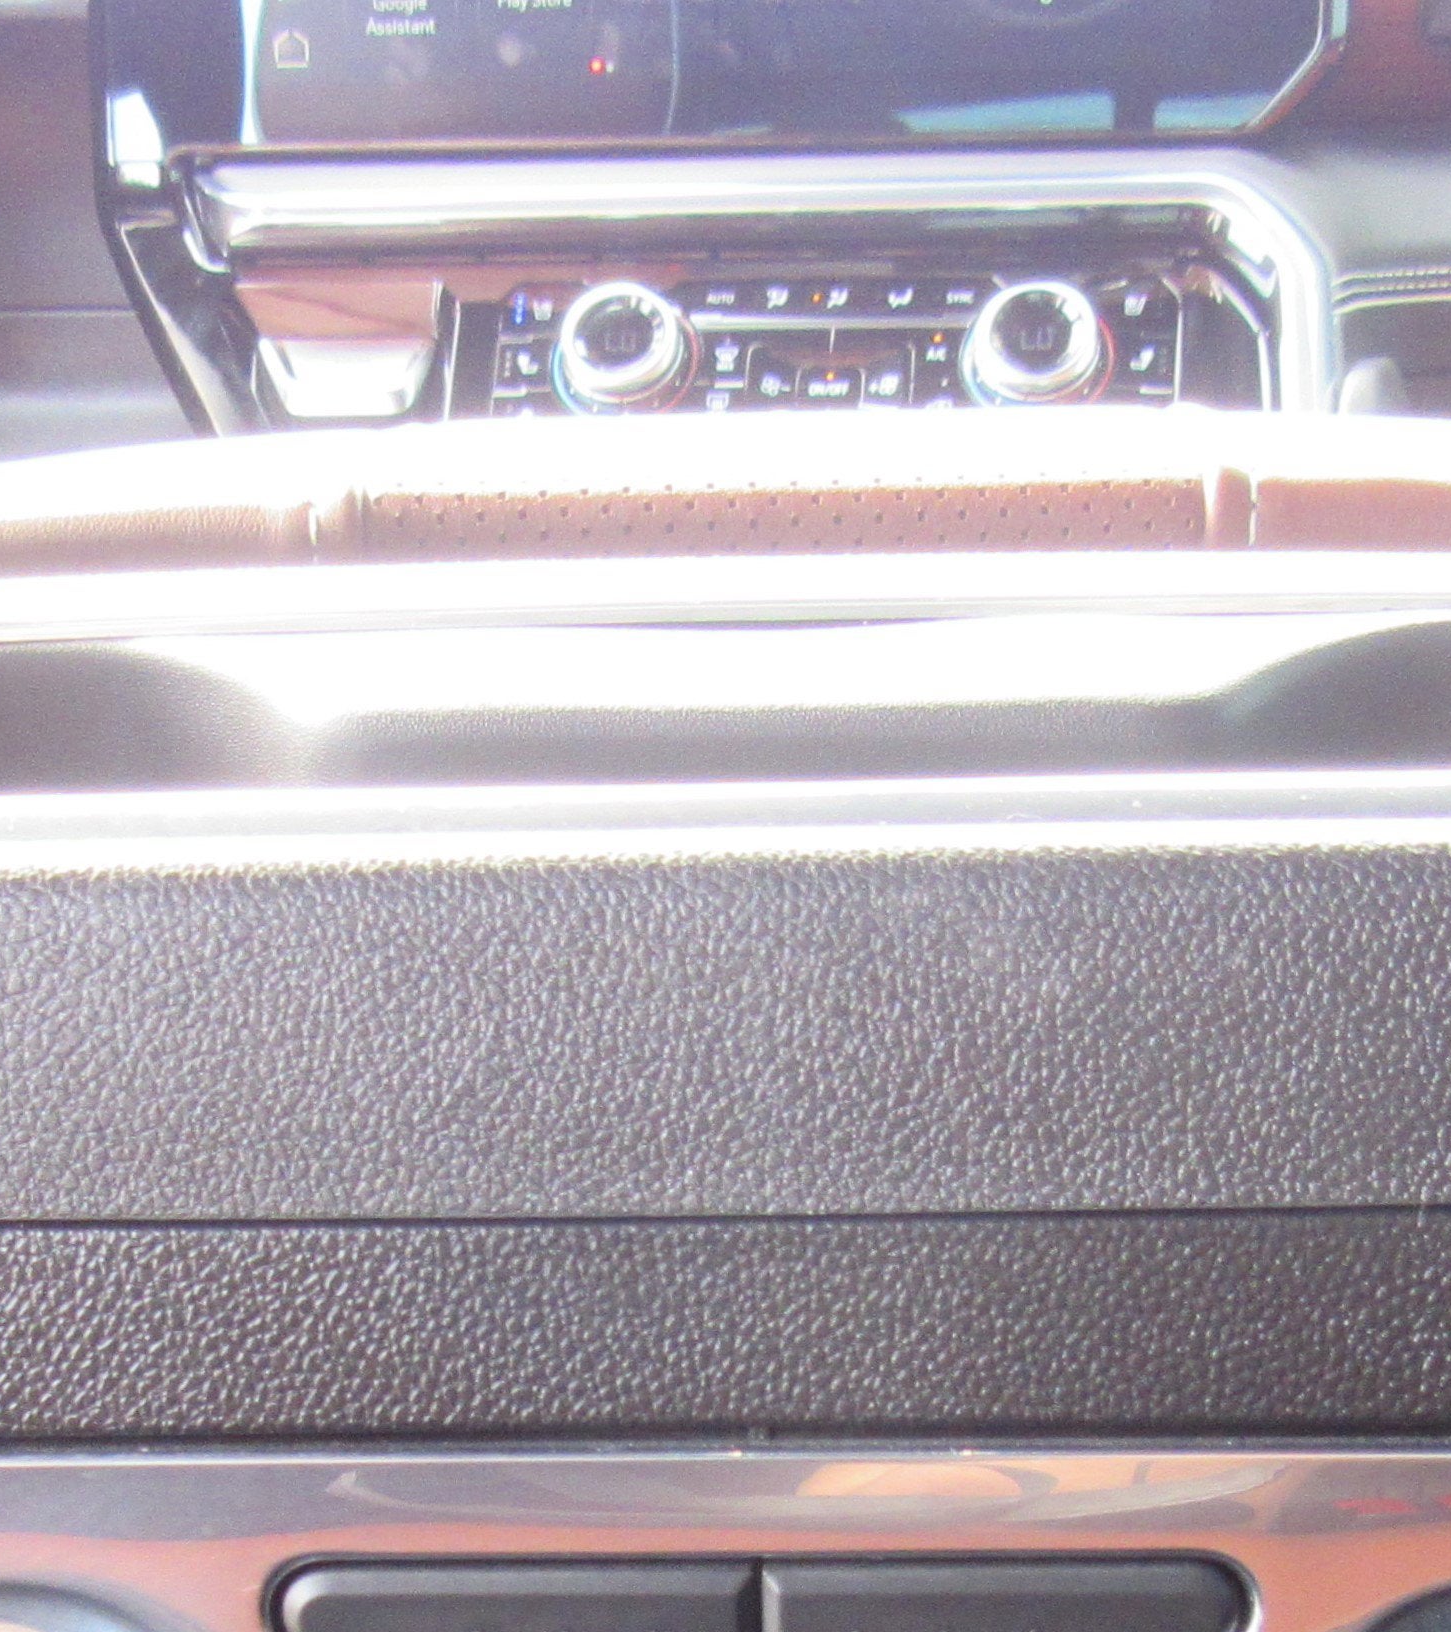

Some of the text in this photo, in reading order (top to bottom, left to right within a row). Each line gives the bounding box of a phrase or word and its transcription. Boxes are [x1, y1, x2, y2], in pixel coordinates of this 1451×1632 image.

[366, 17, 436, 36] Assistant
[706, 292, 735, 306] AUTO
[808, 380, 850, 397] ON/OFF
